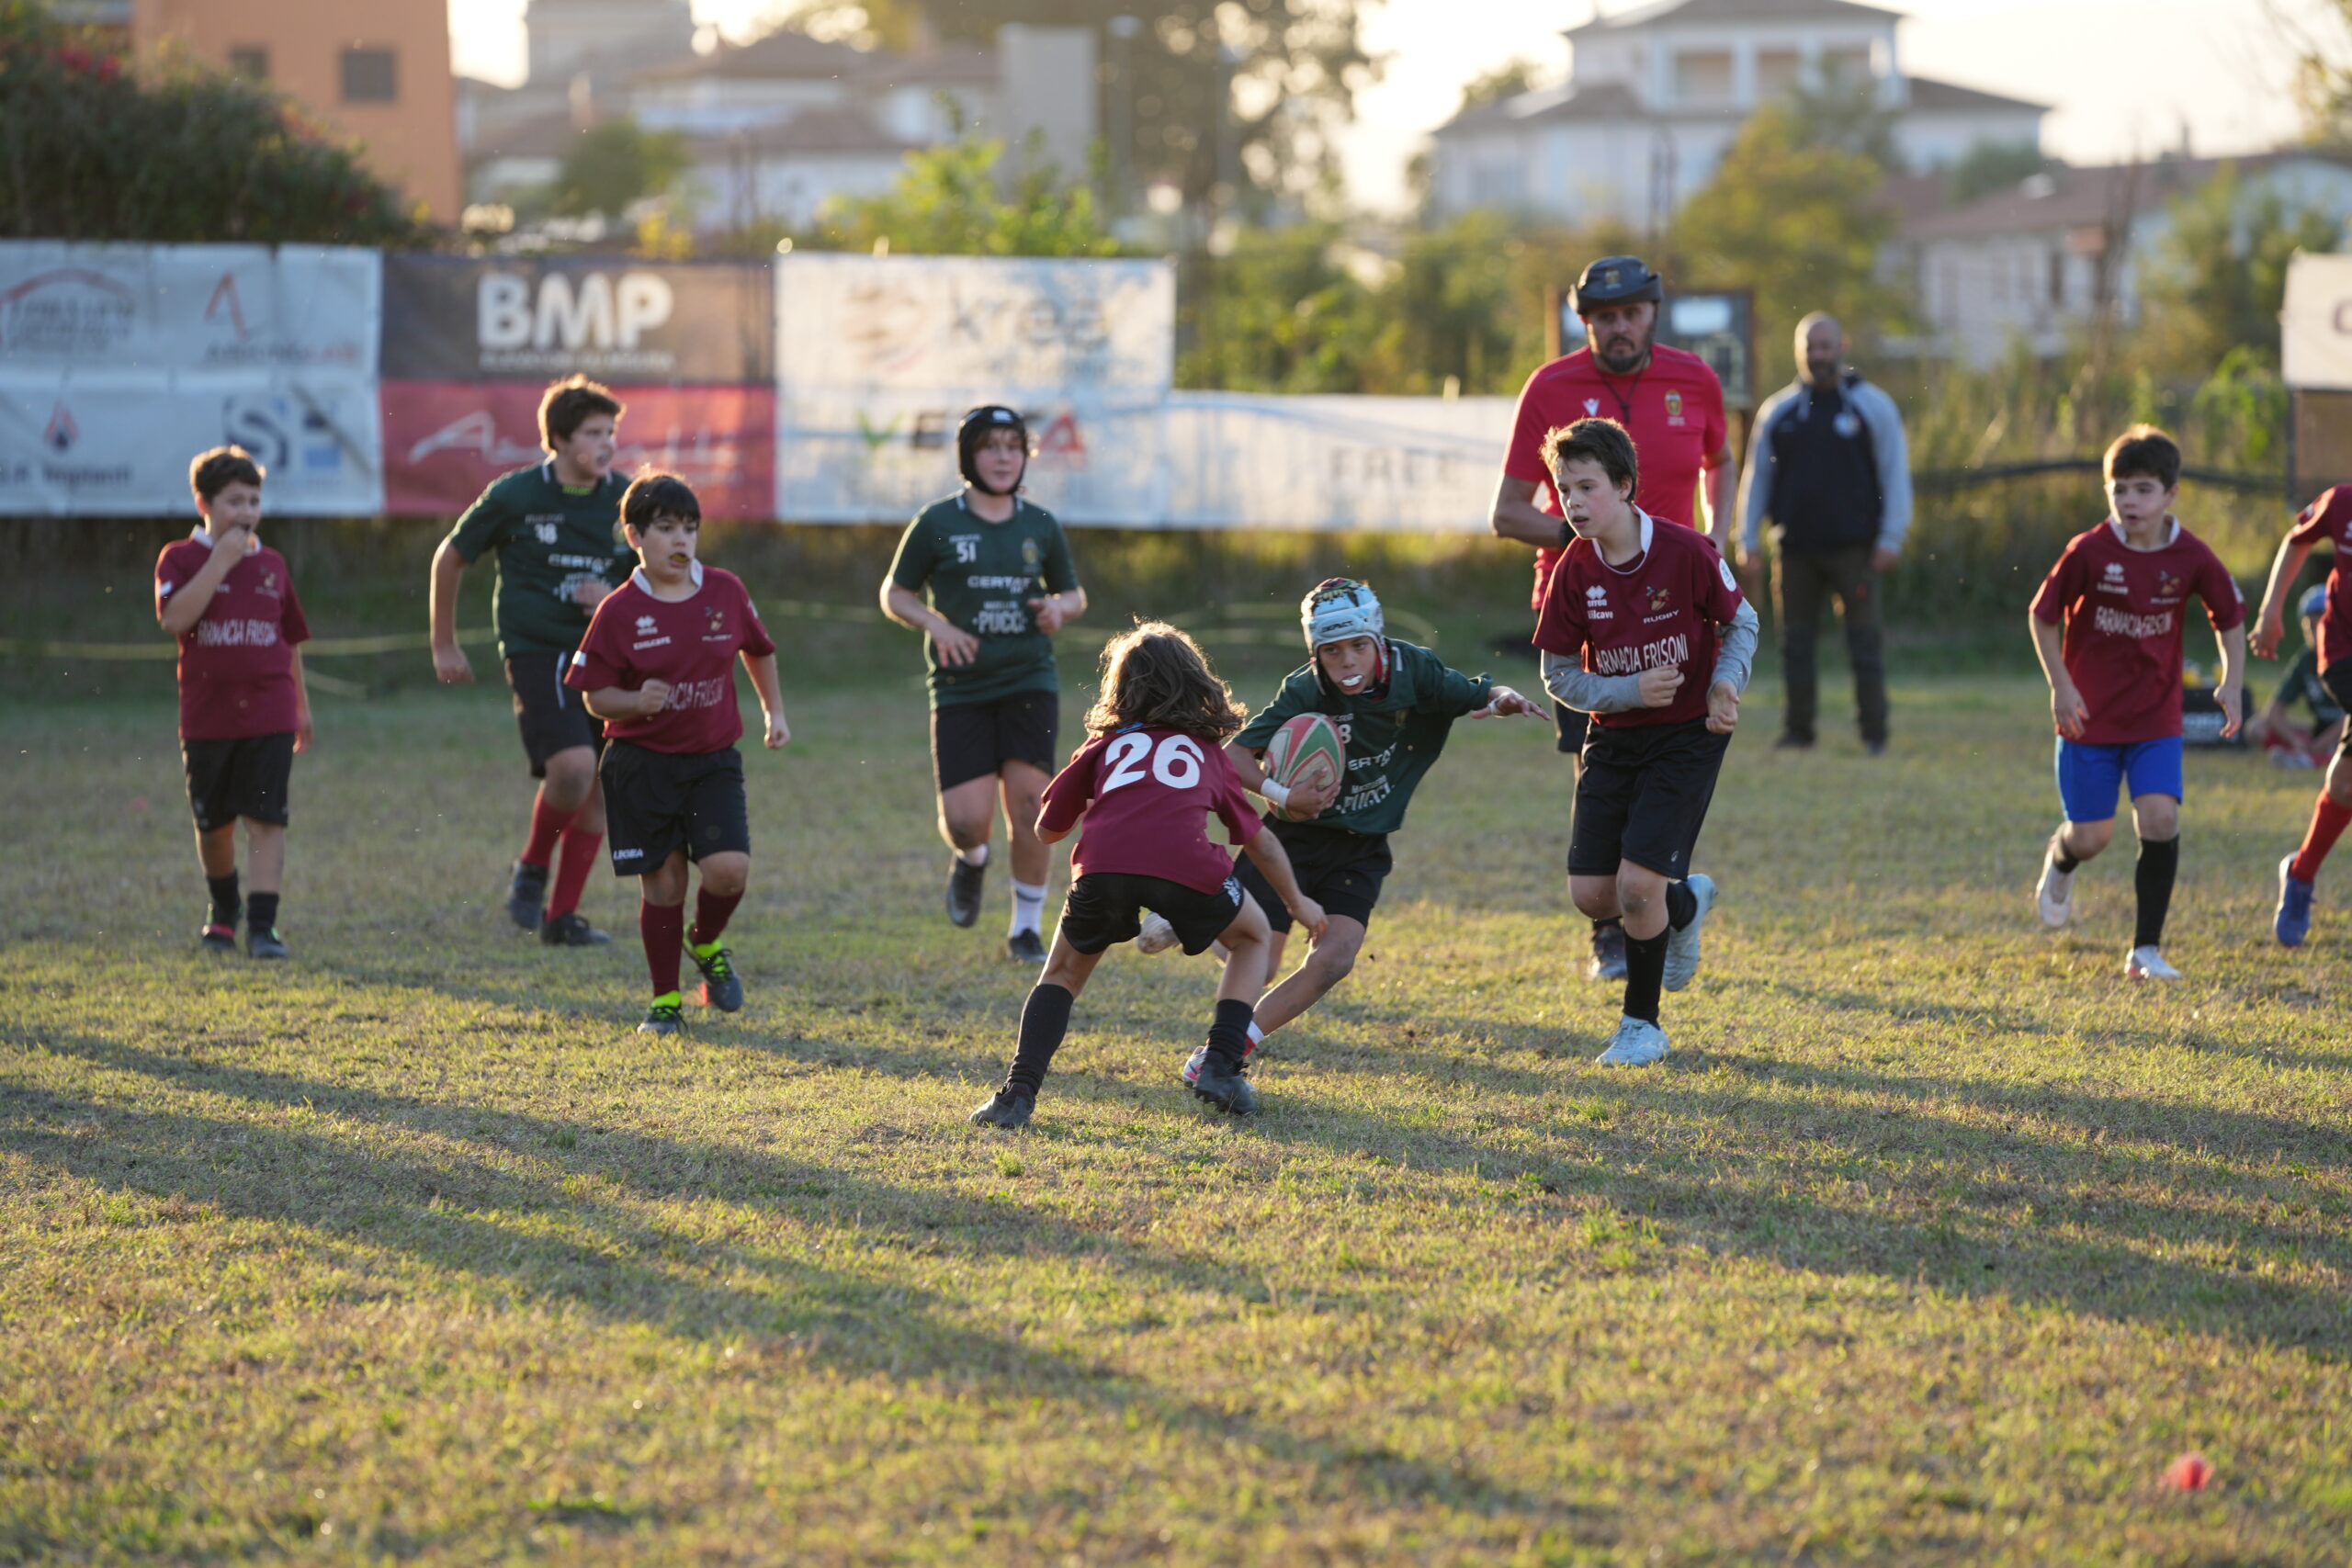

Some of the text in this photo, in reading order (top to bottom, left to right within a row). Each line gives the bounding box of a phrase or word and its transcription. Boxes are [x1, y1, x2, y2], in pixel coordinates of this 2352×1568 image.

[477, 272, 673, 350] BMP
[956, 541, 977, 563] 51
[1644, 610, 1679, 624] RUGBY
[1596, 645, 1643, 674] ARMACIA
[1102, 732, 1204, 794] 26
